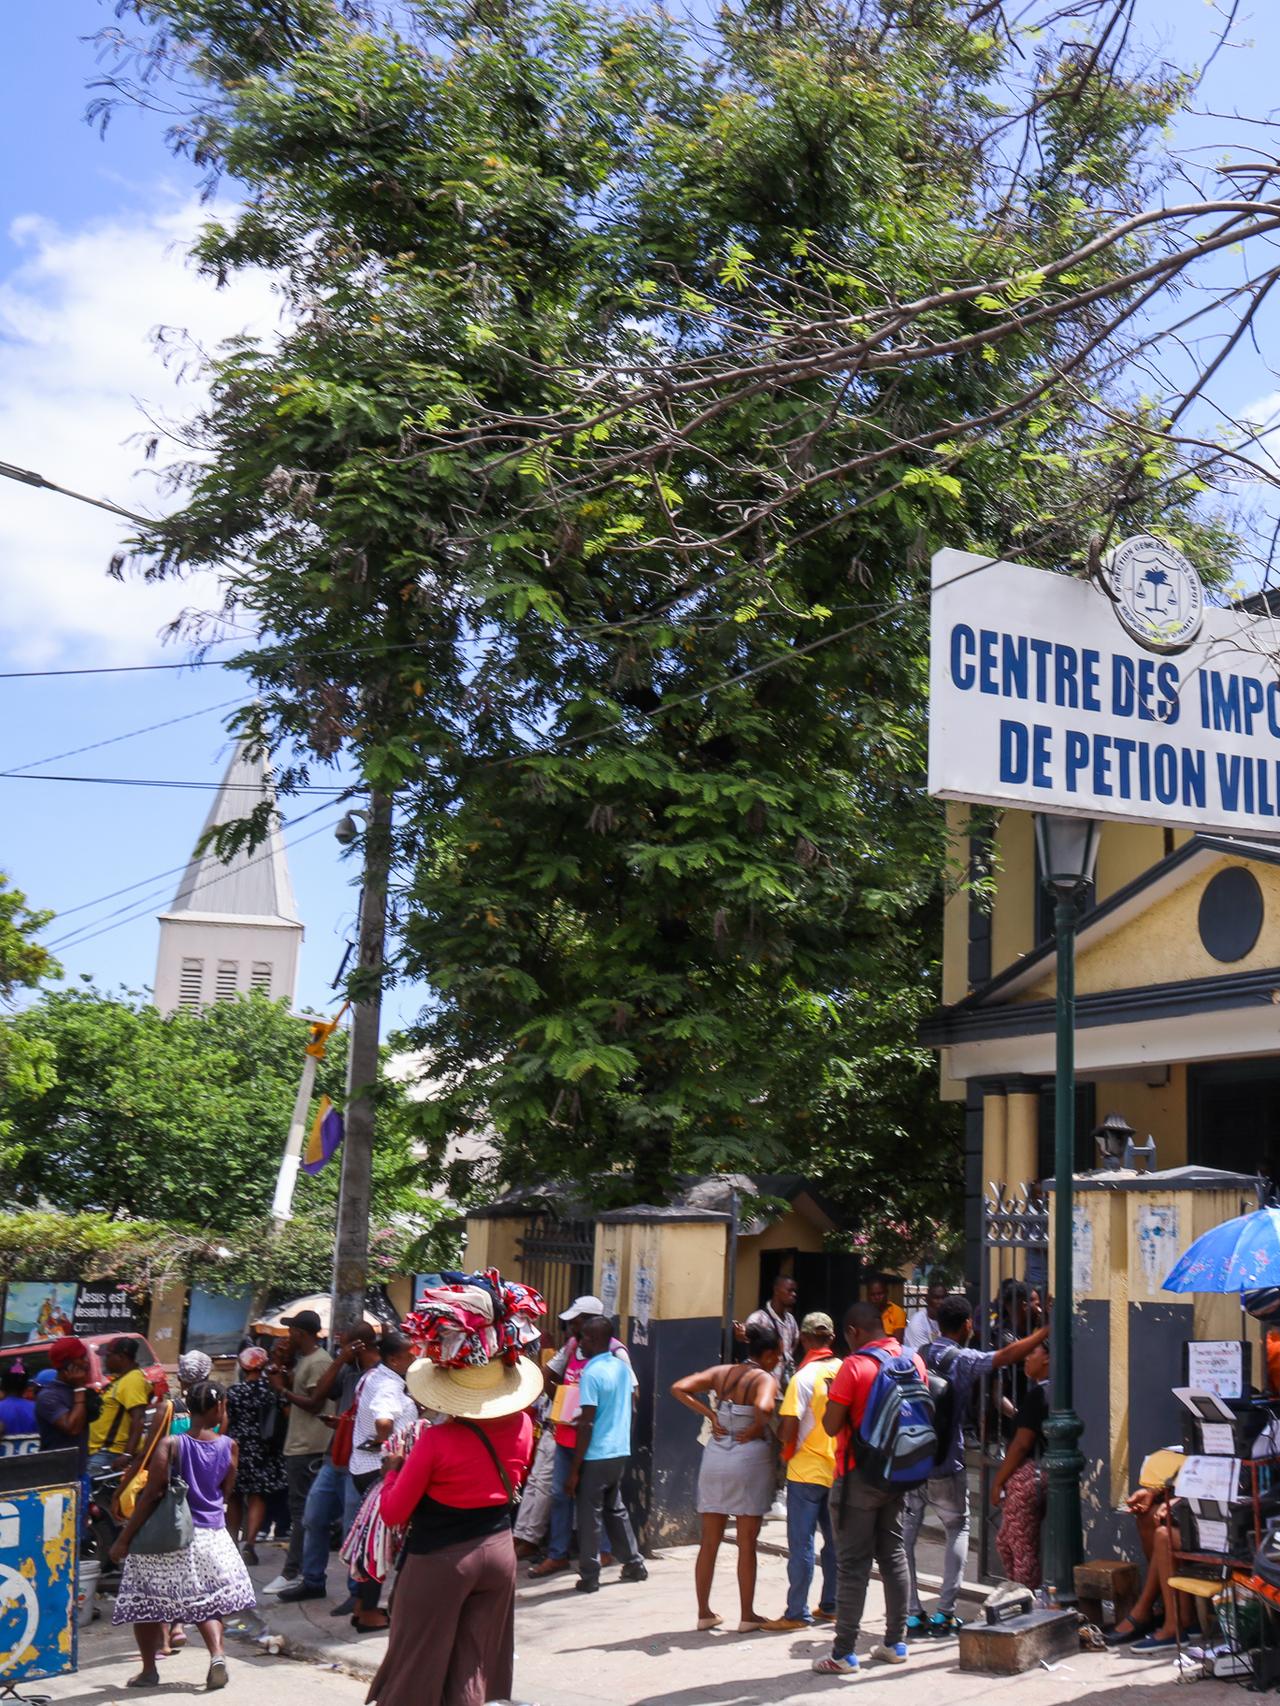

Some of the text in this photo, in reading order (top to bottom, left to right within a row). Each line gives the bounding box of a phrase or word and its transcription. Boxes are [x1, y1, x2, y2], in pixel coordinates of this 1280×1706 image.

[951, 624, 1101, 713] CENTRE
[1112, 654, 1180, 725] DES
[1000, 719, 1053, 790] DE
[1066, 730, 1206, 809] PETION
